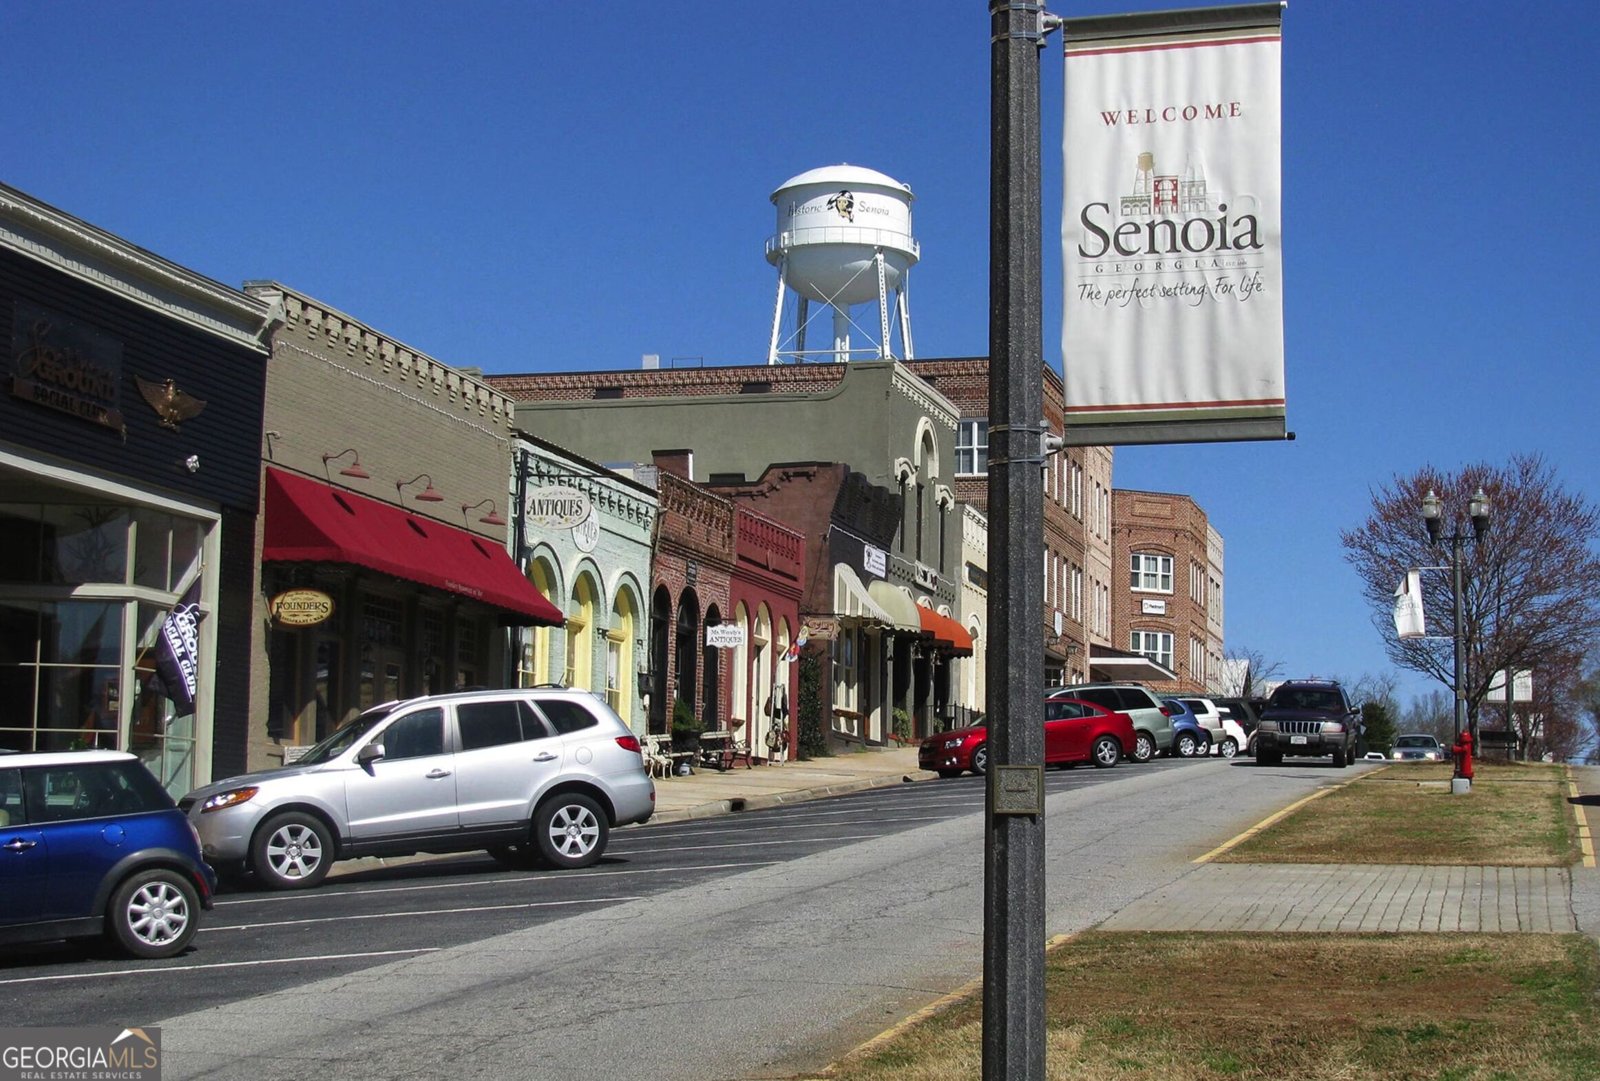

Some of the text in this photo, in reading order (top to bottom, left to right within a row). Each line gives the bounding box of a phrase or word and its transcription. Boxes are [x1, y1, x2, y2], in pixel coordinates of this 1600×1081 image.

[1100, 102, 1242, 126] WELCOME
[788, 200, 890, 217] Historic Senoia
[1077, 202, 1265, 259] Senoia
[1095, 259, 1219, 274] GEORGIA
[1078, 283, 1102, 301] The
[1104, 277, 1157, 307] perfect
[1159, 282, 1207, 307] setting.
[1215, 275, 1236, 295] For
[526, 498, 583, 519] ANTIQUES
[275, 601, 329, 614] FOUNDERS
[709, 636, 743, 645] ANTIQUES
